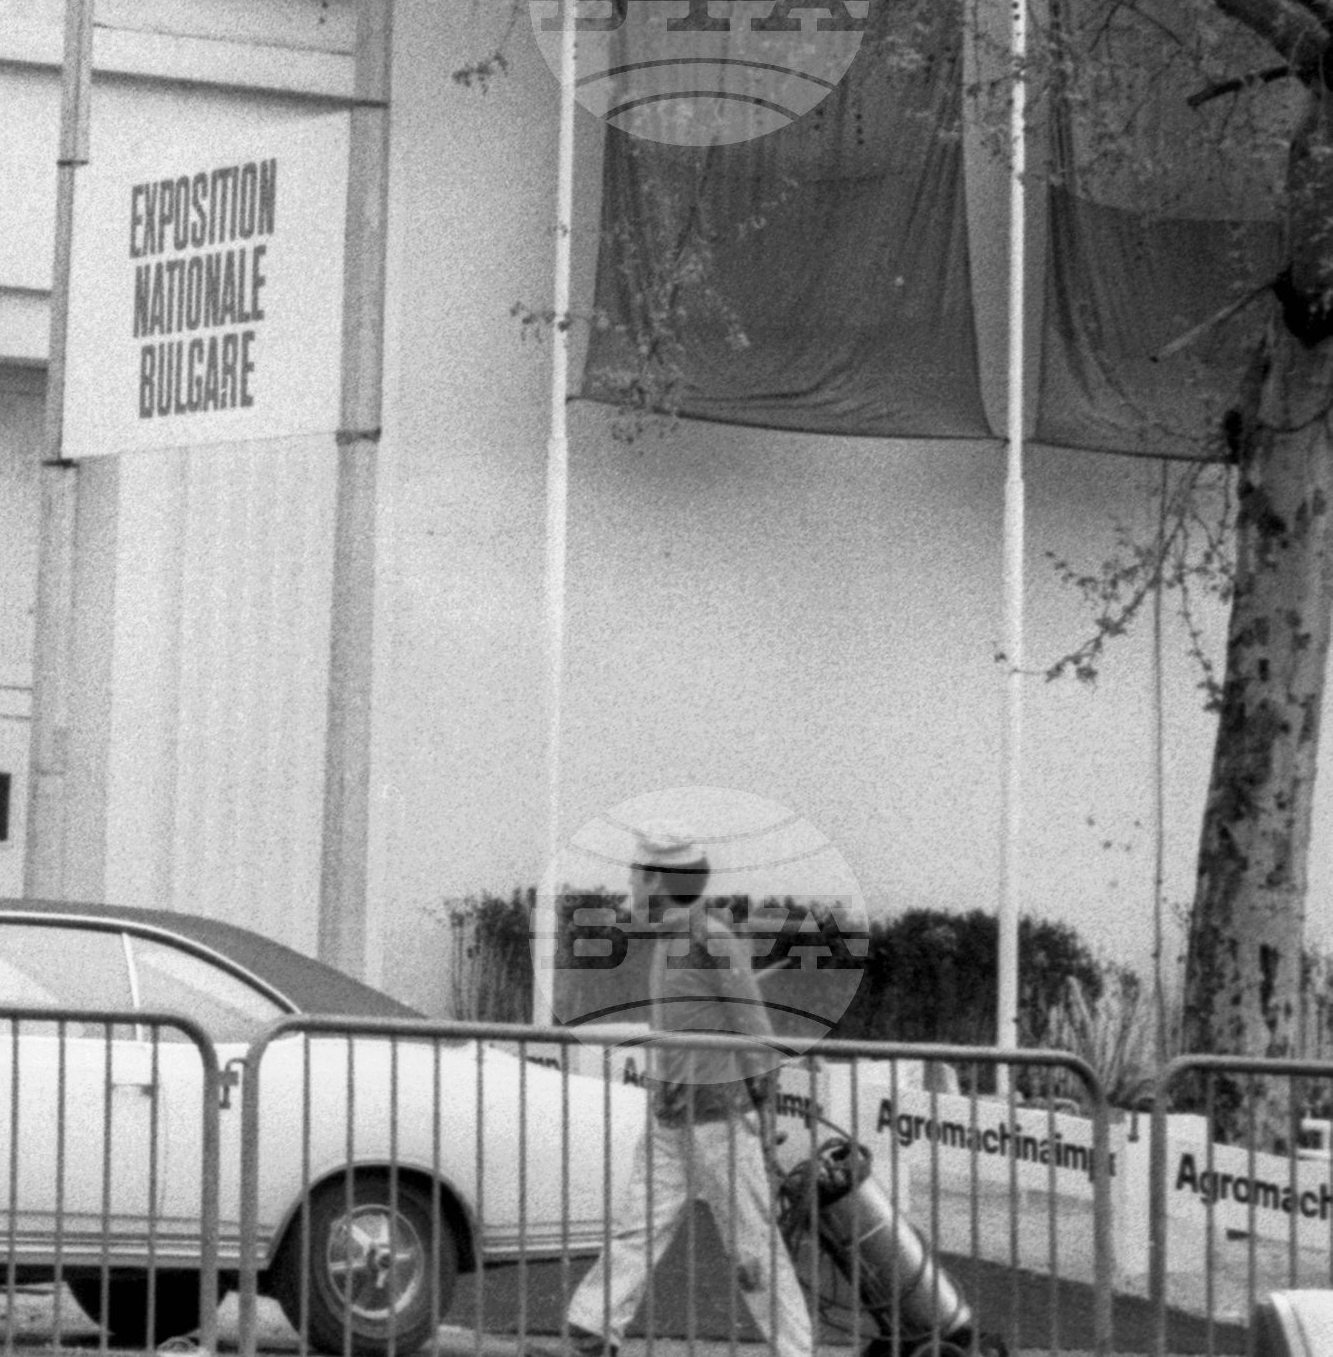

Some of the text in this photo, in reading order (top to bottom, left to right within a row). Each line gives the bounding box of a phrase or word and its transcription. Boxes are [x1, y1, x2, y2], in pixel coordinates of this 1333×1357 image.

[129, 157, 277, 259] EXPOSITION
[132, 244, 267, 339] NATIONALE
[138, 329, 256, 419] BULGARE
